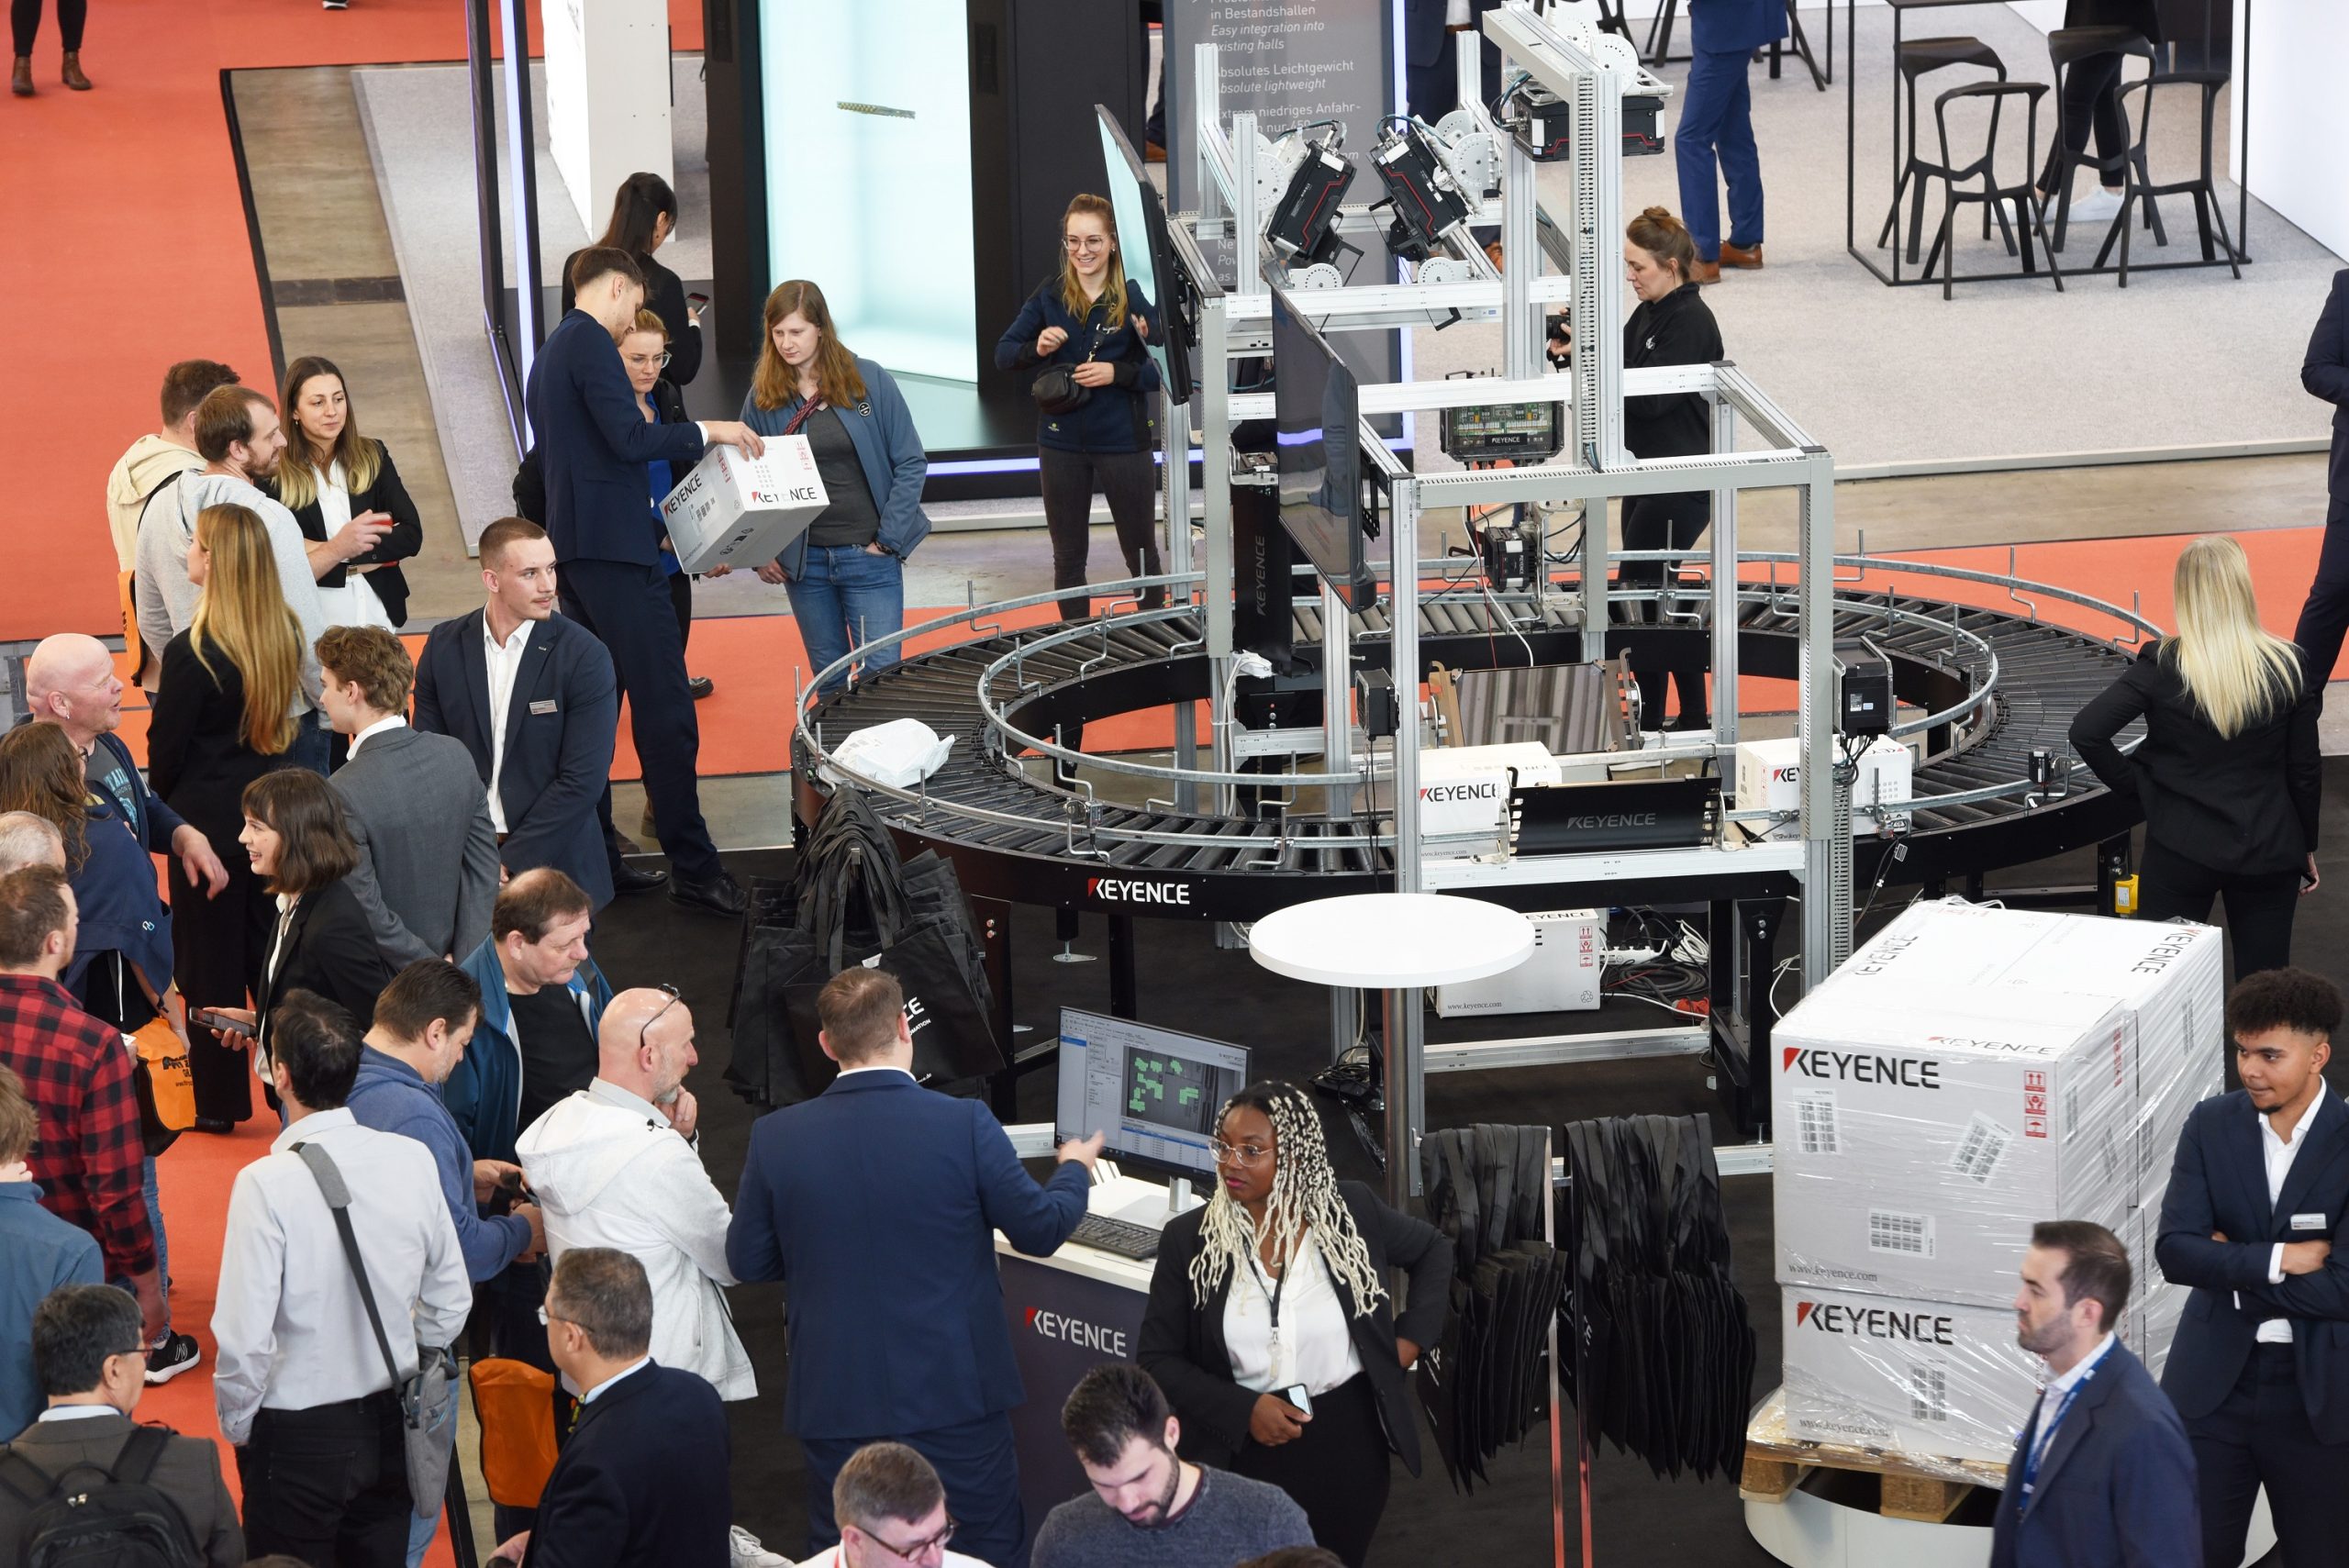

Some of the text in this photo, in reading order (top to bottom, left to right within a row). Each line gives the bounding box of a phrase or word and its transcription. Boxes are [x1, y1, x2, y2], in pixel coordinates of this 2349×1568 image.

[1211, 5, 1316, 19] in Bestandshallen
[1211, 20, 1325, 38] Easy integration into
[1217, 39, 1285, 53] xisting halls
[1218, 61, 1354, 77] bsolutes Leichtgewicht
[1219, 78, 1326, 94] bsolute lightweight
[1259, 105, 1313, 118] niedriges
[1316, 103, 1362, 114] Anfahr-
[1266, 124, 1286, 133] nur
[663, 473, 702, 518] KEYENCE
[1255, 535, 1266, 617] KEYENCE
[1567, 813, 1656, 829] KEYENCE
[1087, 878, 1190, 905] KEYENCE
[1525, 911, 1591, 920] EYENCE
[2131, 928, 2202, 974] KEYENCE
[1447, 1001, 1502, 1011] www.keyence.com
[1928, 1037, 2056, 1055] KEYENCE
[1783, 1047, 1941, 1089] KEYENCE
[1788, 1262, 1878, 1283] www.keyence.com
[1025, 1307, 1127, 1358] KEYENCE
[1797, 1301, 1954, 1346] KEYENCE
